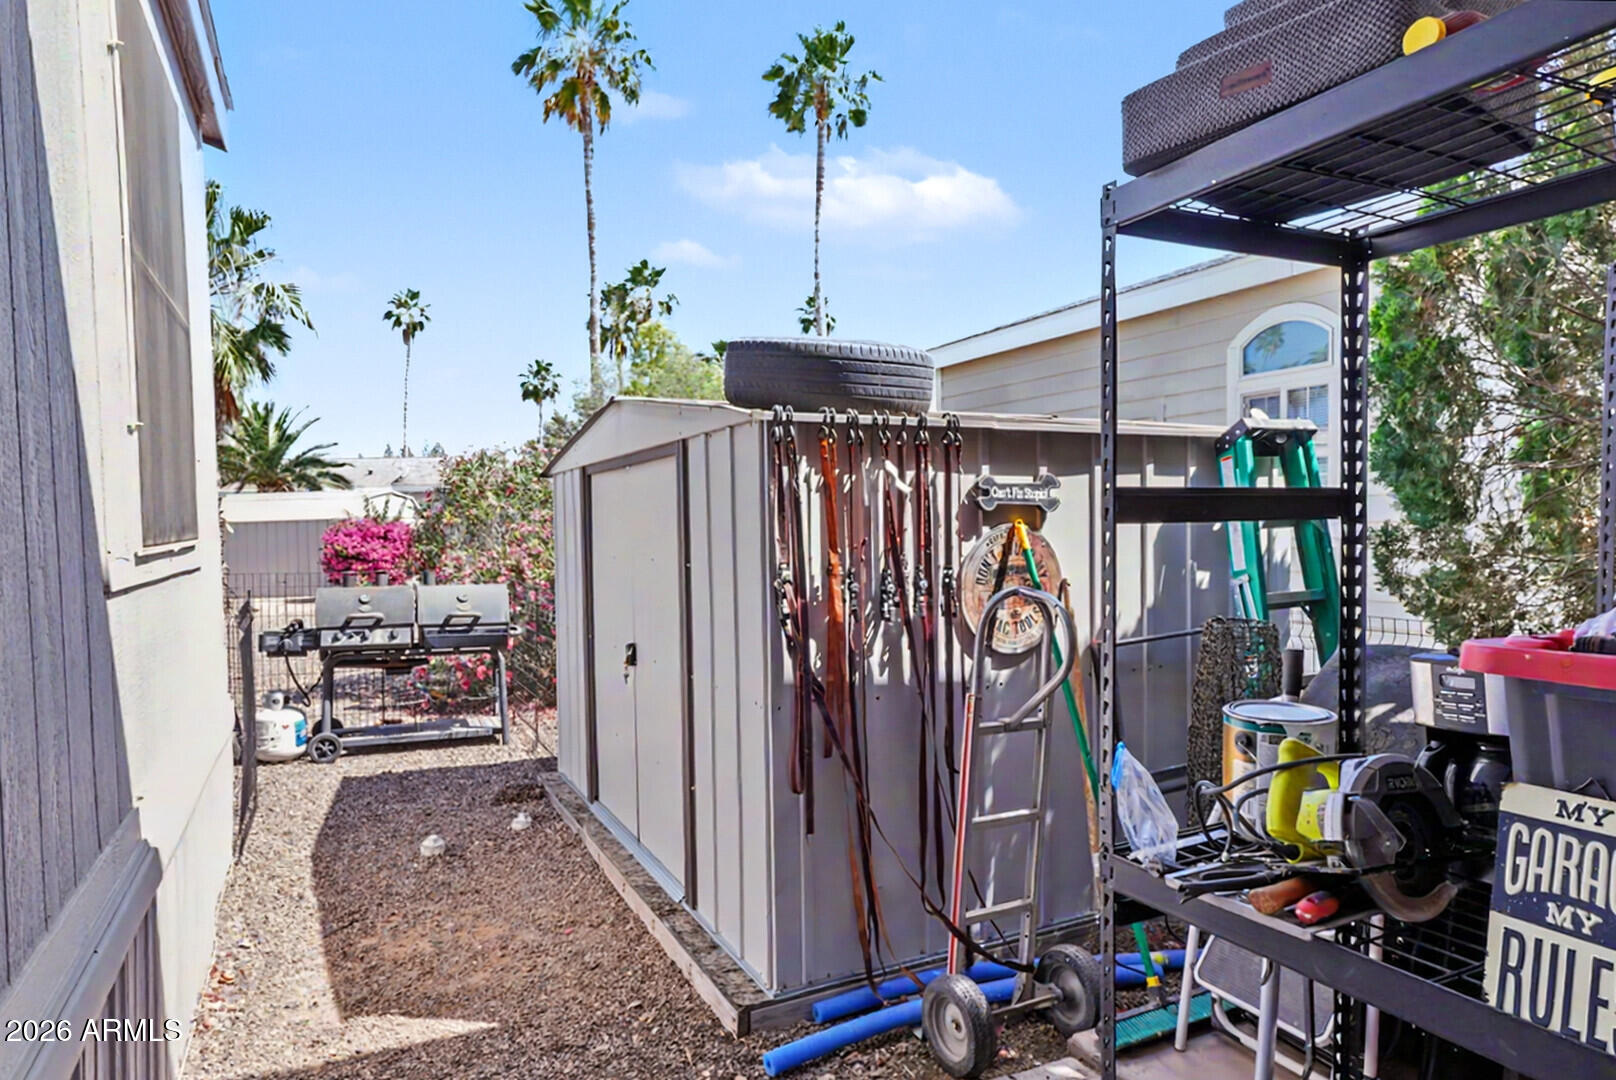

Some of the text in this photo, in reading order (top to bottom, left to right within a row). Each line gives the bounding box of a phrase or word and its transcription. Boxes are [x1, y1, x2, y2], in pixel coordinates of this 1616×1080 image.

[1555, 799, 1615, 827] MY
[1504, 821, 1616, 916] GARA
[1545, 901, 1603, 936] MY
[1496, 925, 1616, 1054] RULE
